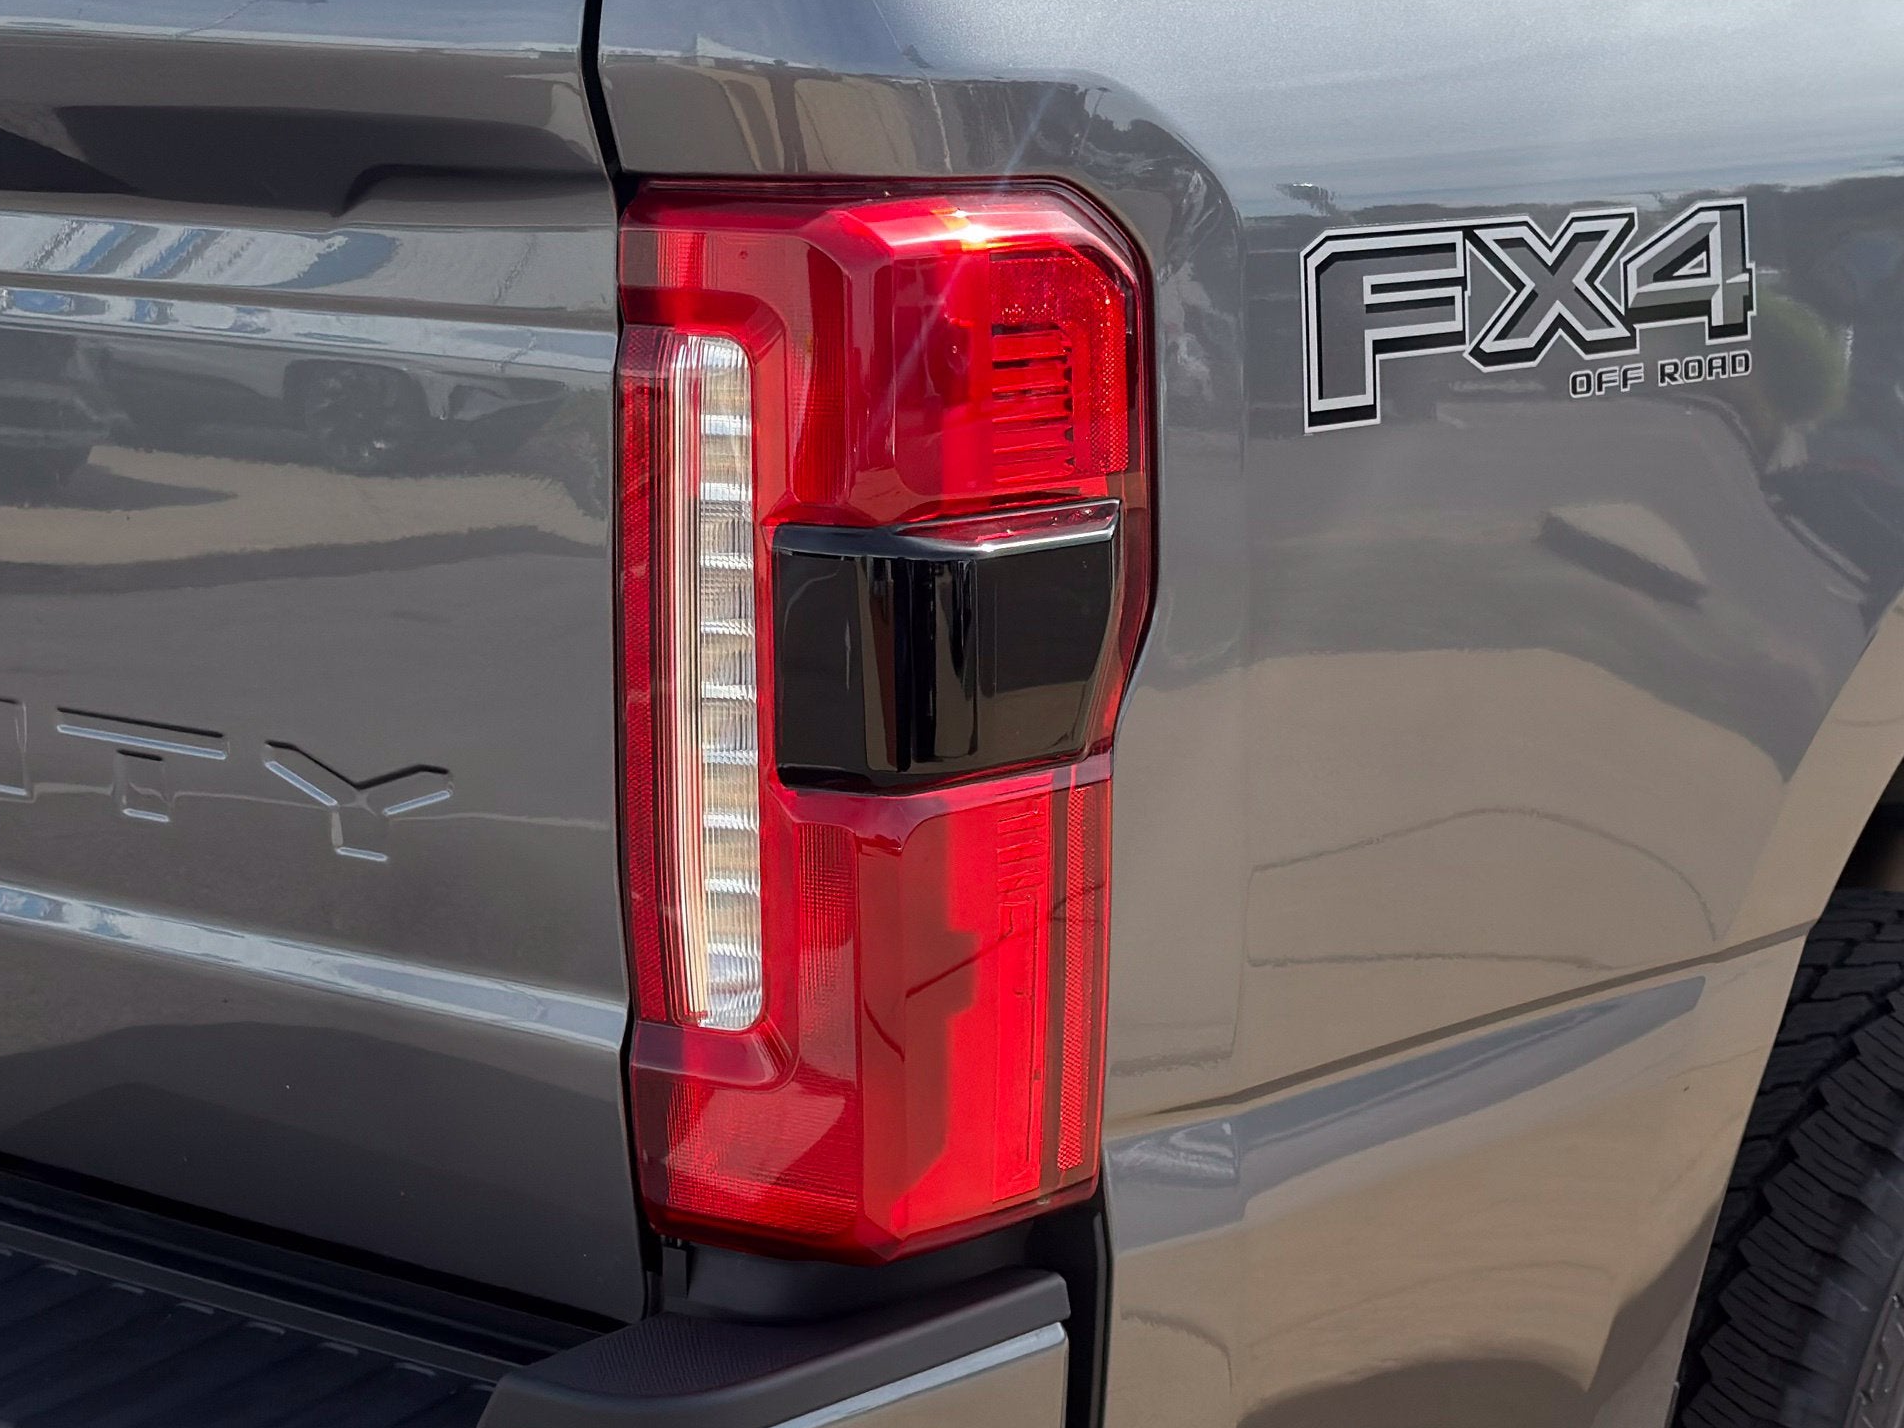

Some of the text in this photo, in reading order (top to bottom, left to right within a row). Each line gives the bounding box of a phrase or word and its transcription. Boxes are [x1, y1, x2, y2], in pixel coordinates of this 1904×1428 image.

[1300, 197, 1756, 435] FX4
[1569, 349, 1753, 399] OFF ROAD
